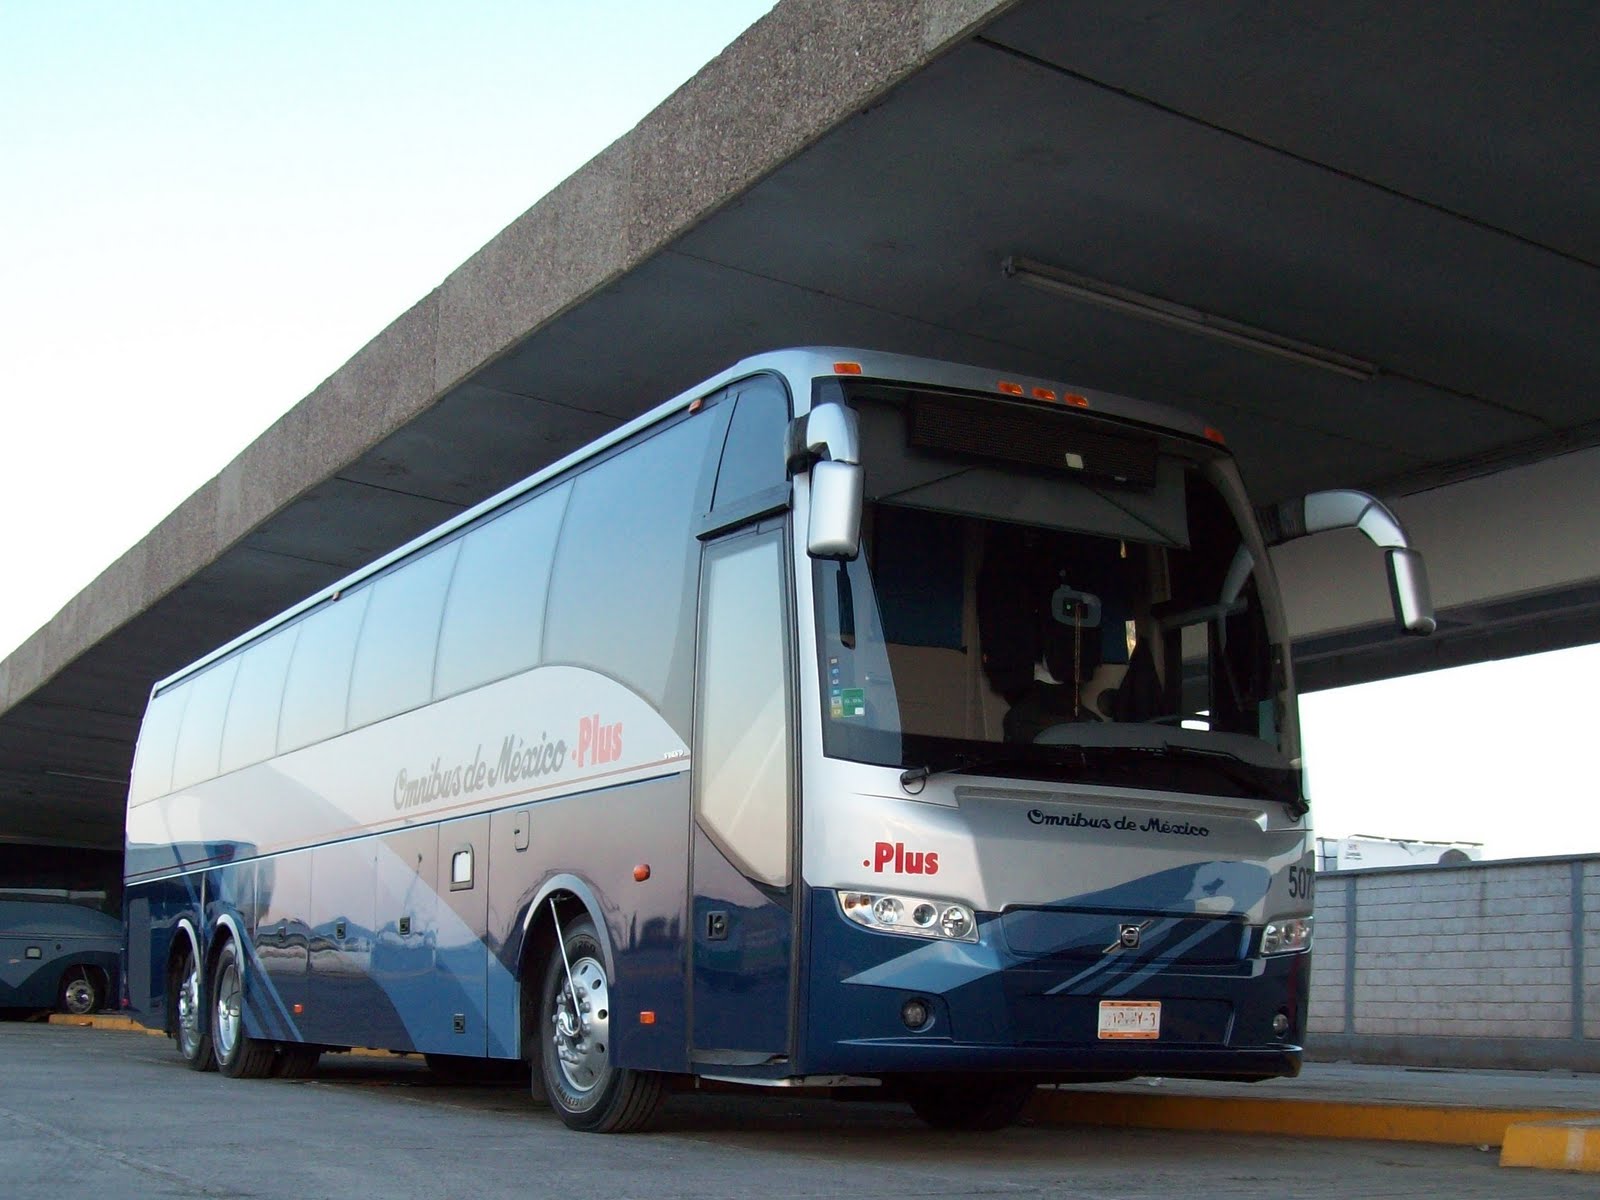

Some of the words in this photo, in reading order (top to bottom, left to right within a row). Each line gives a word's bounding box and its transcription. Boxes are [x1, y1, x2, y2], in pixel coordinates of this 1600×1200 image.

[393, 756, 463, 810] Omnibus
[463, 743, 487, 794] de
[487, 731, 567, 788] México
[1027, 809, 1112, 830] Omnibus
[1114, 816, 1137, 831] de
[1140, 817, 1210, 837] México
[1288, 865, 1315, 900] 507
